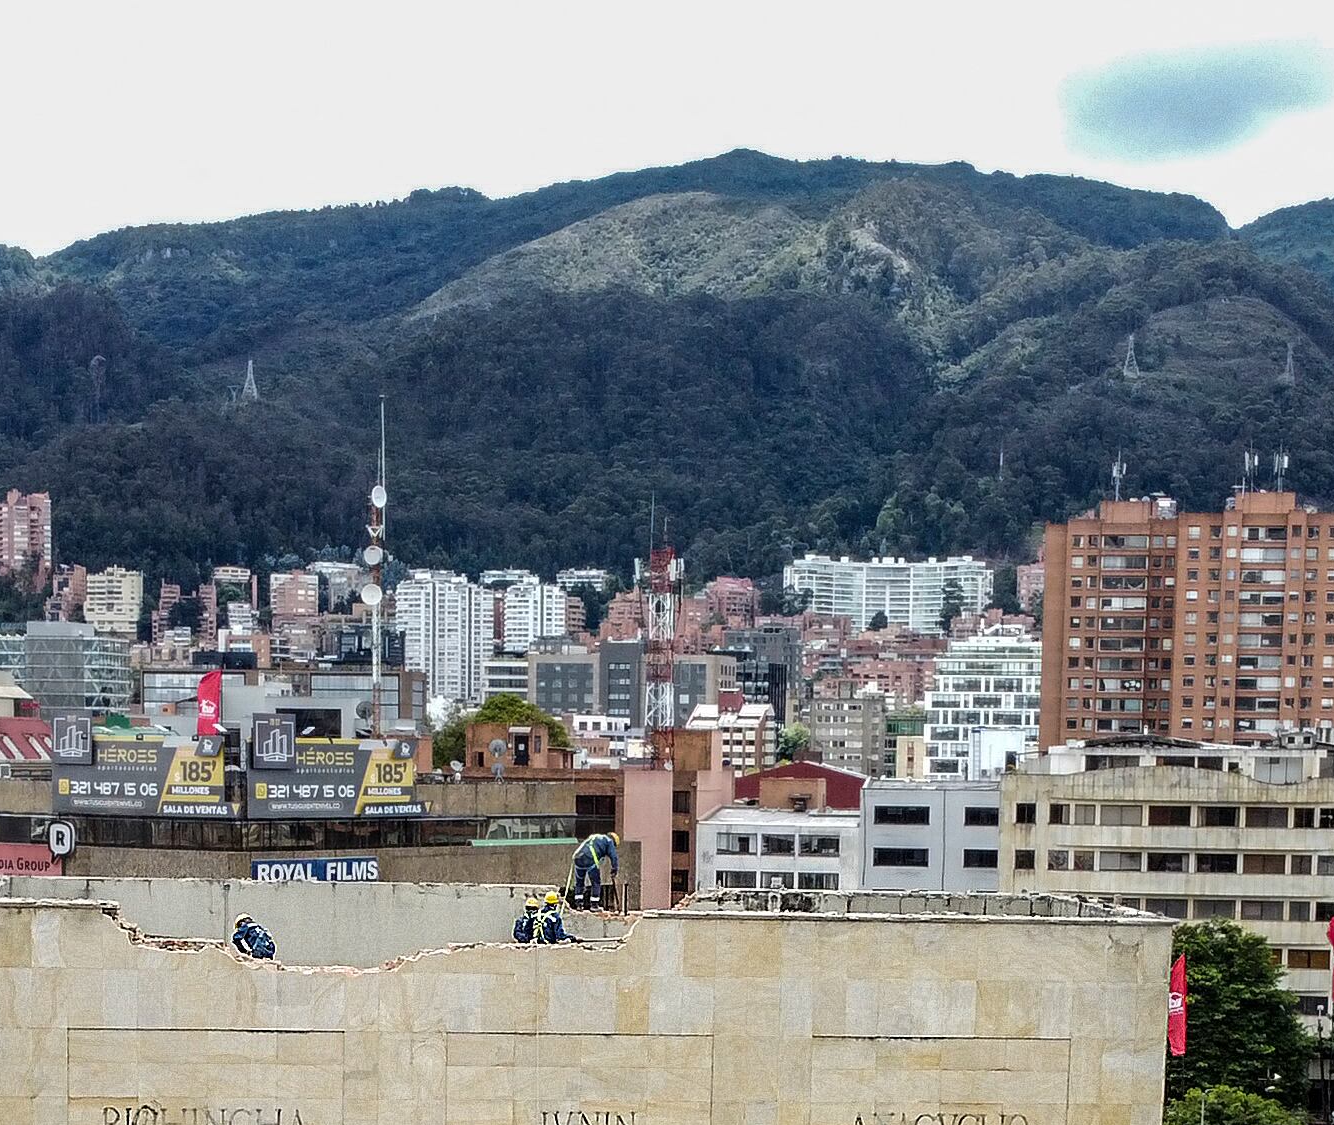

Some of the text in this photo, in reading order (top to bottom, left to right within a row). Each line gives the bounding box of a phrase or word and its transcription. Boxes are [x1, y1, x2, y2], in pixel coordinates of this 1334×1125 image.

[97, 745, 157, 763] HÉROES
[295, 747, 354, 766] HÉROES
[70, 780, 158, 797] 321 487 15 06
[268, 784, 355, 798] 321 487 15 06
[163, 804, 183, 814] SALA
[196, 806, 228, 815] VENTAS
[365, 805, 383, 815] SALA
[55, 830, 65, 847] R
[16, 857, 51, 872] GROUP
[257, 860, 379, 881] ROYAL FILMS
